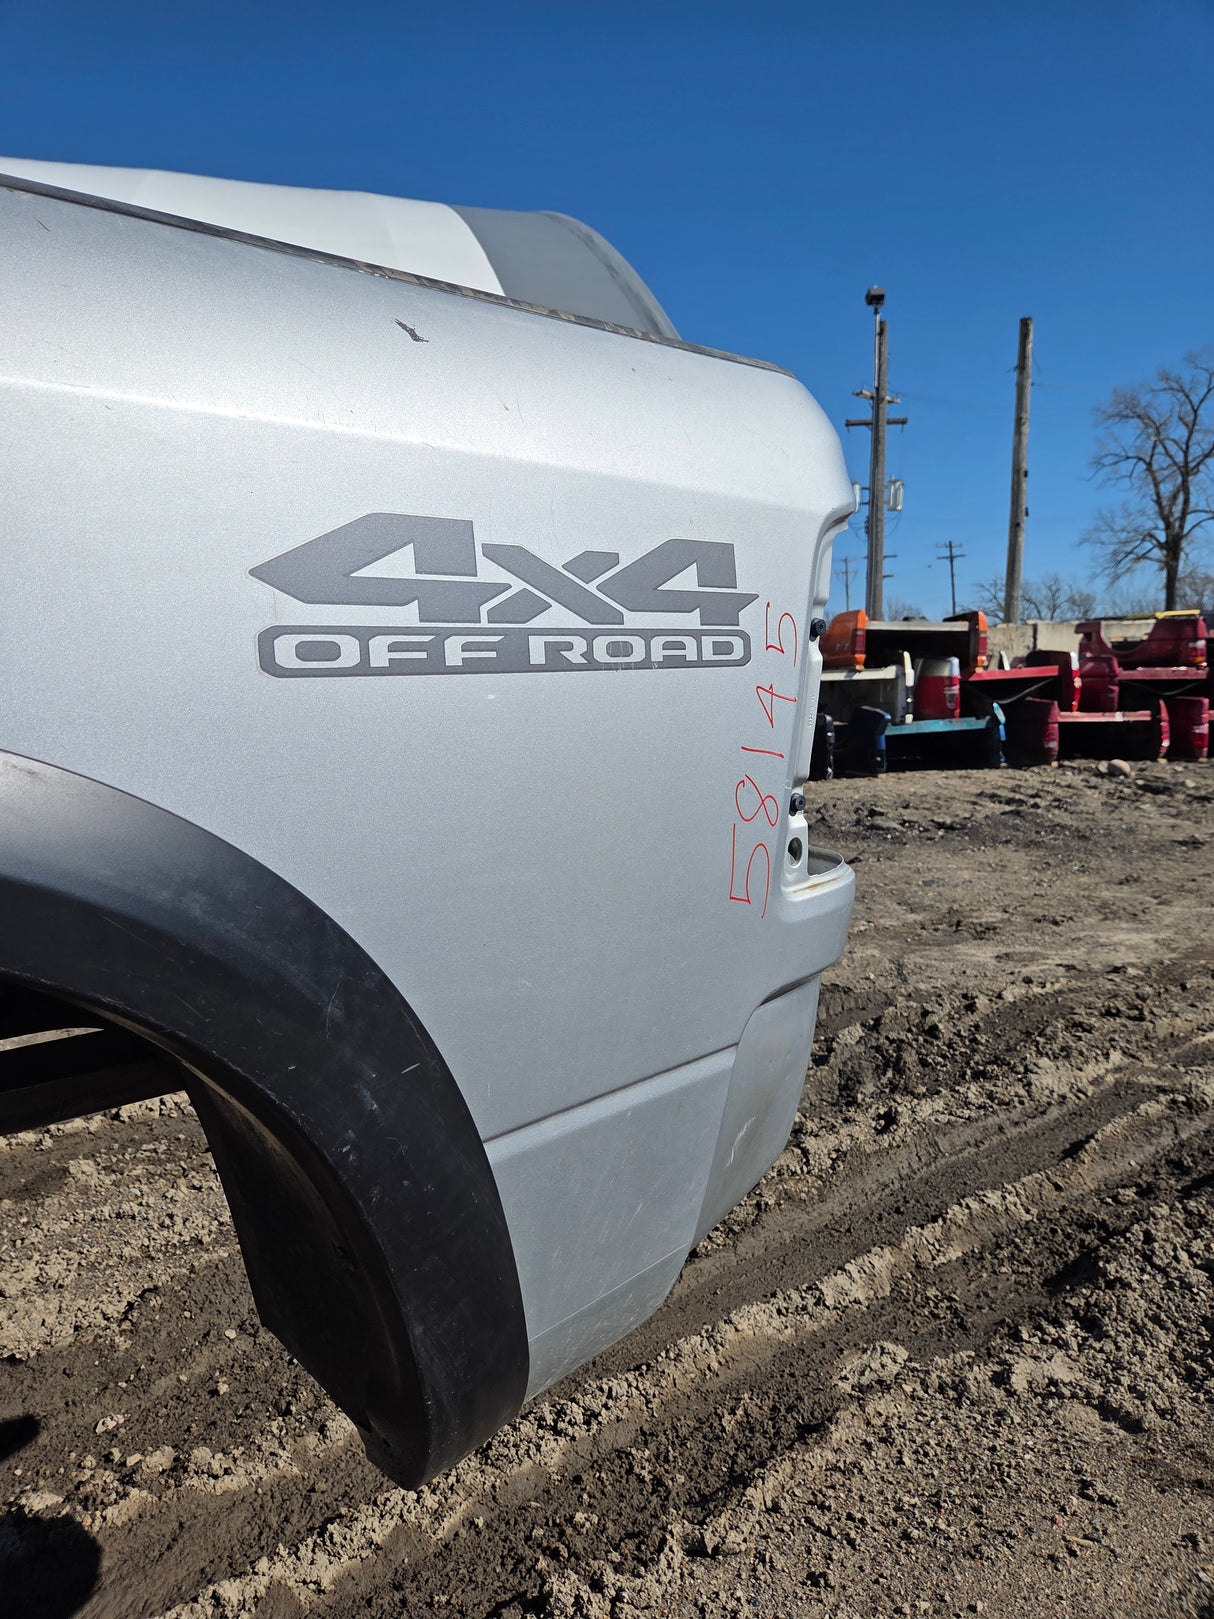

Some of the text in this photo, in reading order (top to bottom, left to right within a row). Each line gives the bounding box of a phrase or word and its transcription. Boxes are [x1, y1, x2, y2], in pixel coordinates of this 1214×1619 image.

[273, 634, 745, 669] OFF ROAD
[729, 601, 797, 919] 58145
